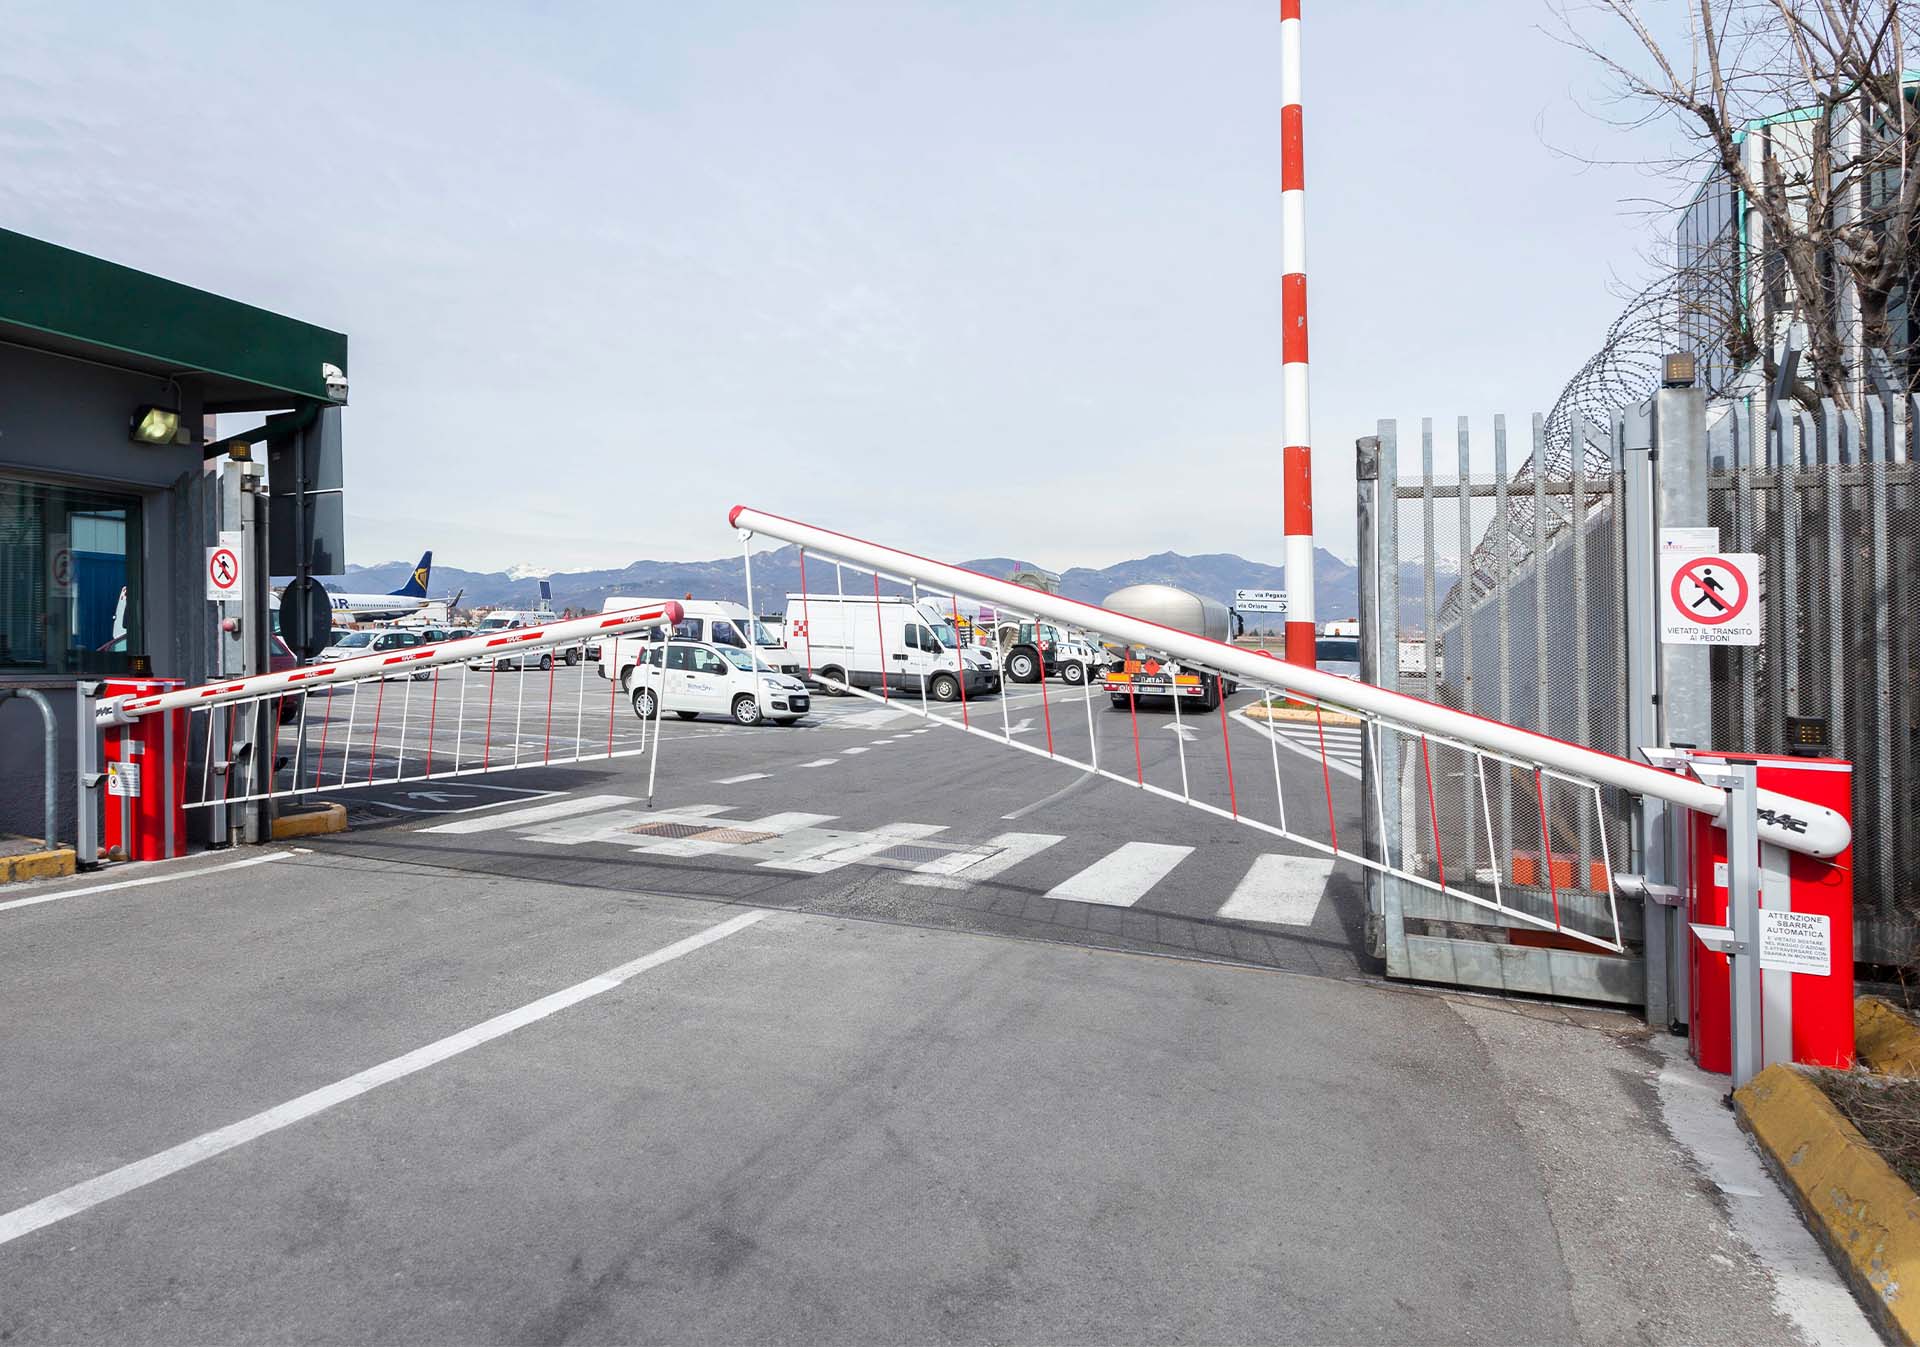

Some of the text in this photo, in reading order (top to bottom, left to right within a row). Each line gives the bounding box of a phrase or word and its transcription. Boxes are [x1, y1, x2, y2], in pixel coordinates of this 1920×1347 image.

[1667, 627, 1753, 636] VIETATO IL TRANSITO
[1700, 634, 1730, 642] PEDONI
[1767, 912, 1823, 924] ATTENZIONE
[1776, 920, 1814, 931] SBARRA
[1766, 927, 1824, 938] AUTOMATICA
